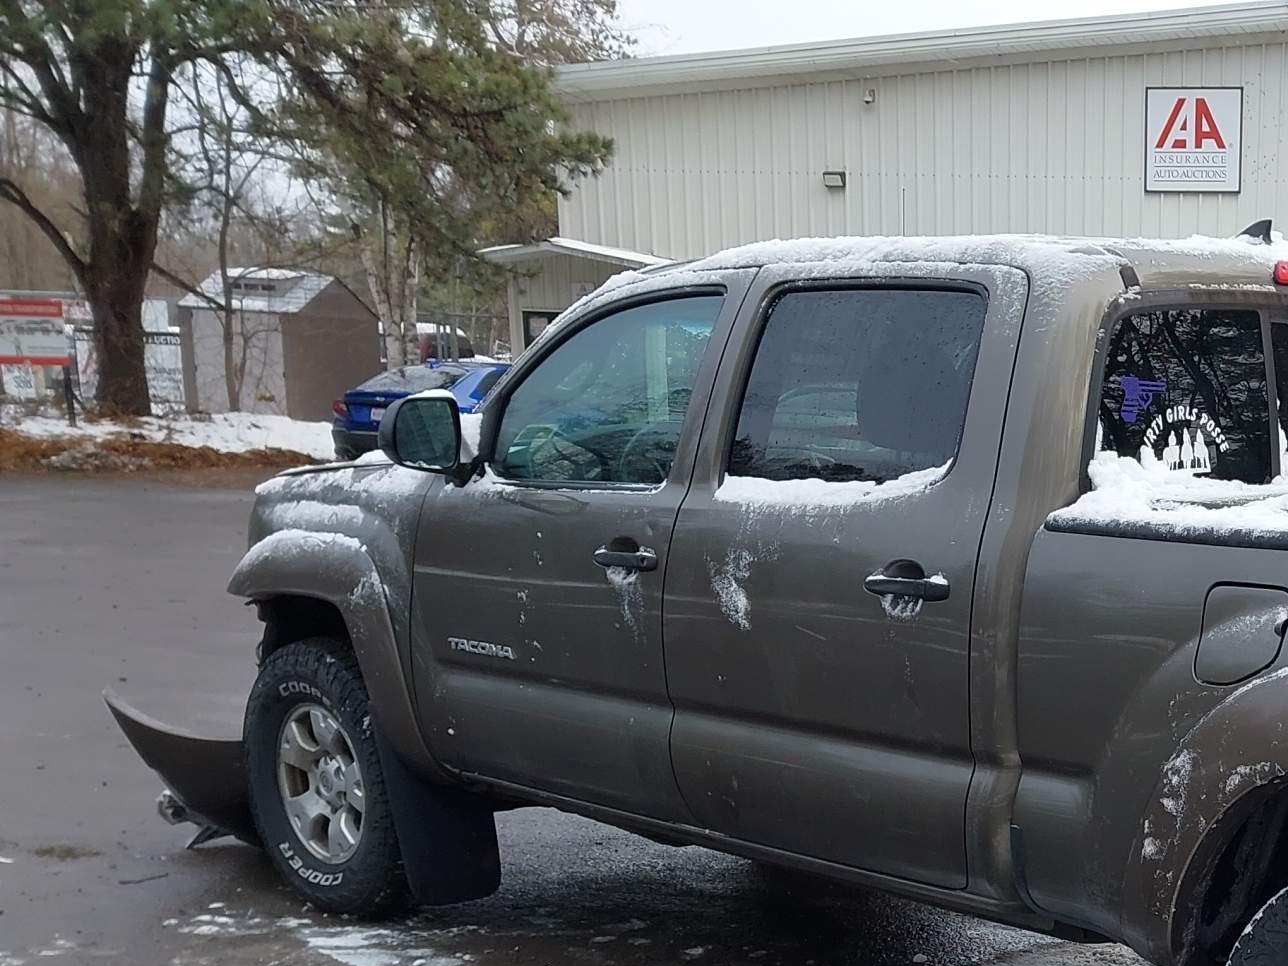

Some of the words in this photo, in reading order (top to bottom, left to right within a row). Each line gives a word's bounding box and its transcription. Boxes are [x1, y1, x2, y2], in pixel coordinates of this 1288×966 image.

[1153, 154, 1227, 165] INSURANCE
[1153, 168, 1180, 179] AUTO
[1180, 168, 1227, 179] AUCTIONS
[1143, 414, 1163, 448] IRTY
[1166, 405, 1198, 423] GIRLS
[1200, 412, 1230, 453] POSSE
[447, 637, 514, 660] TACOMA
[279, 841, 344, 886] COOPER
